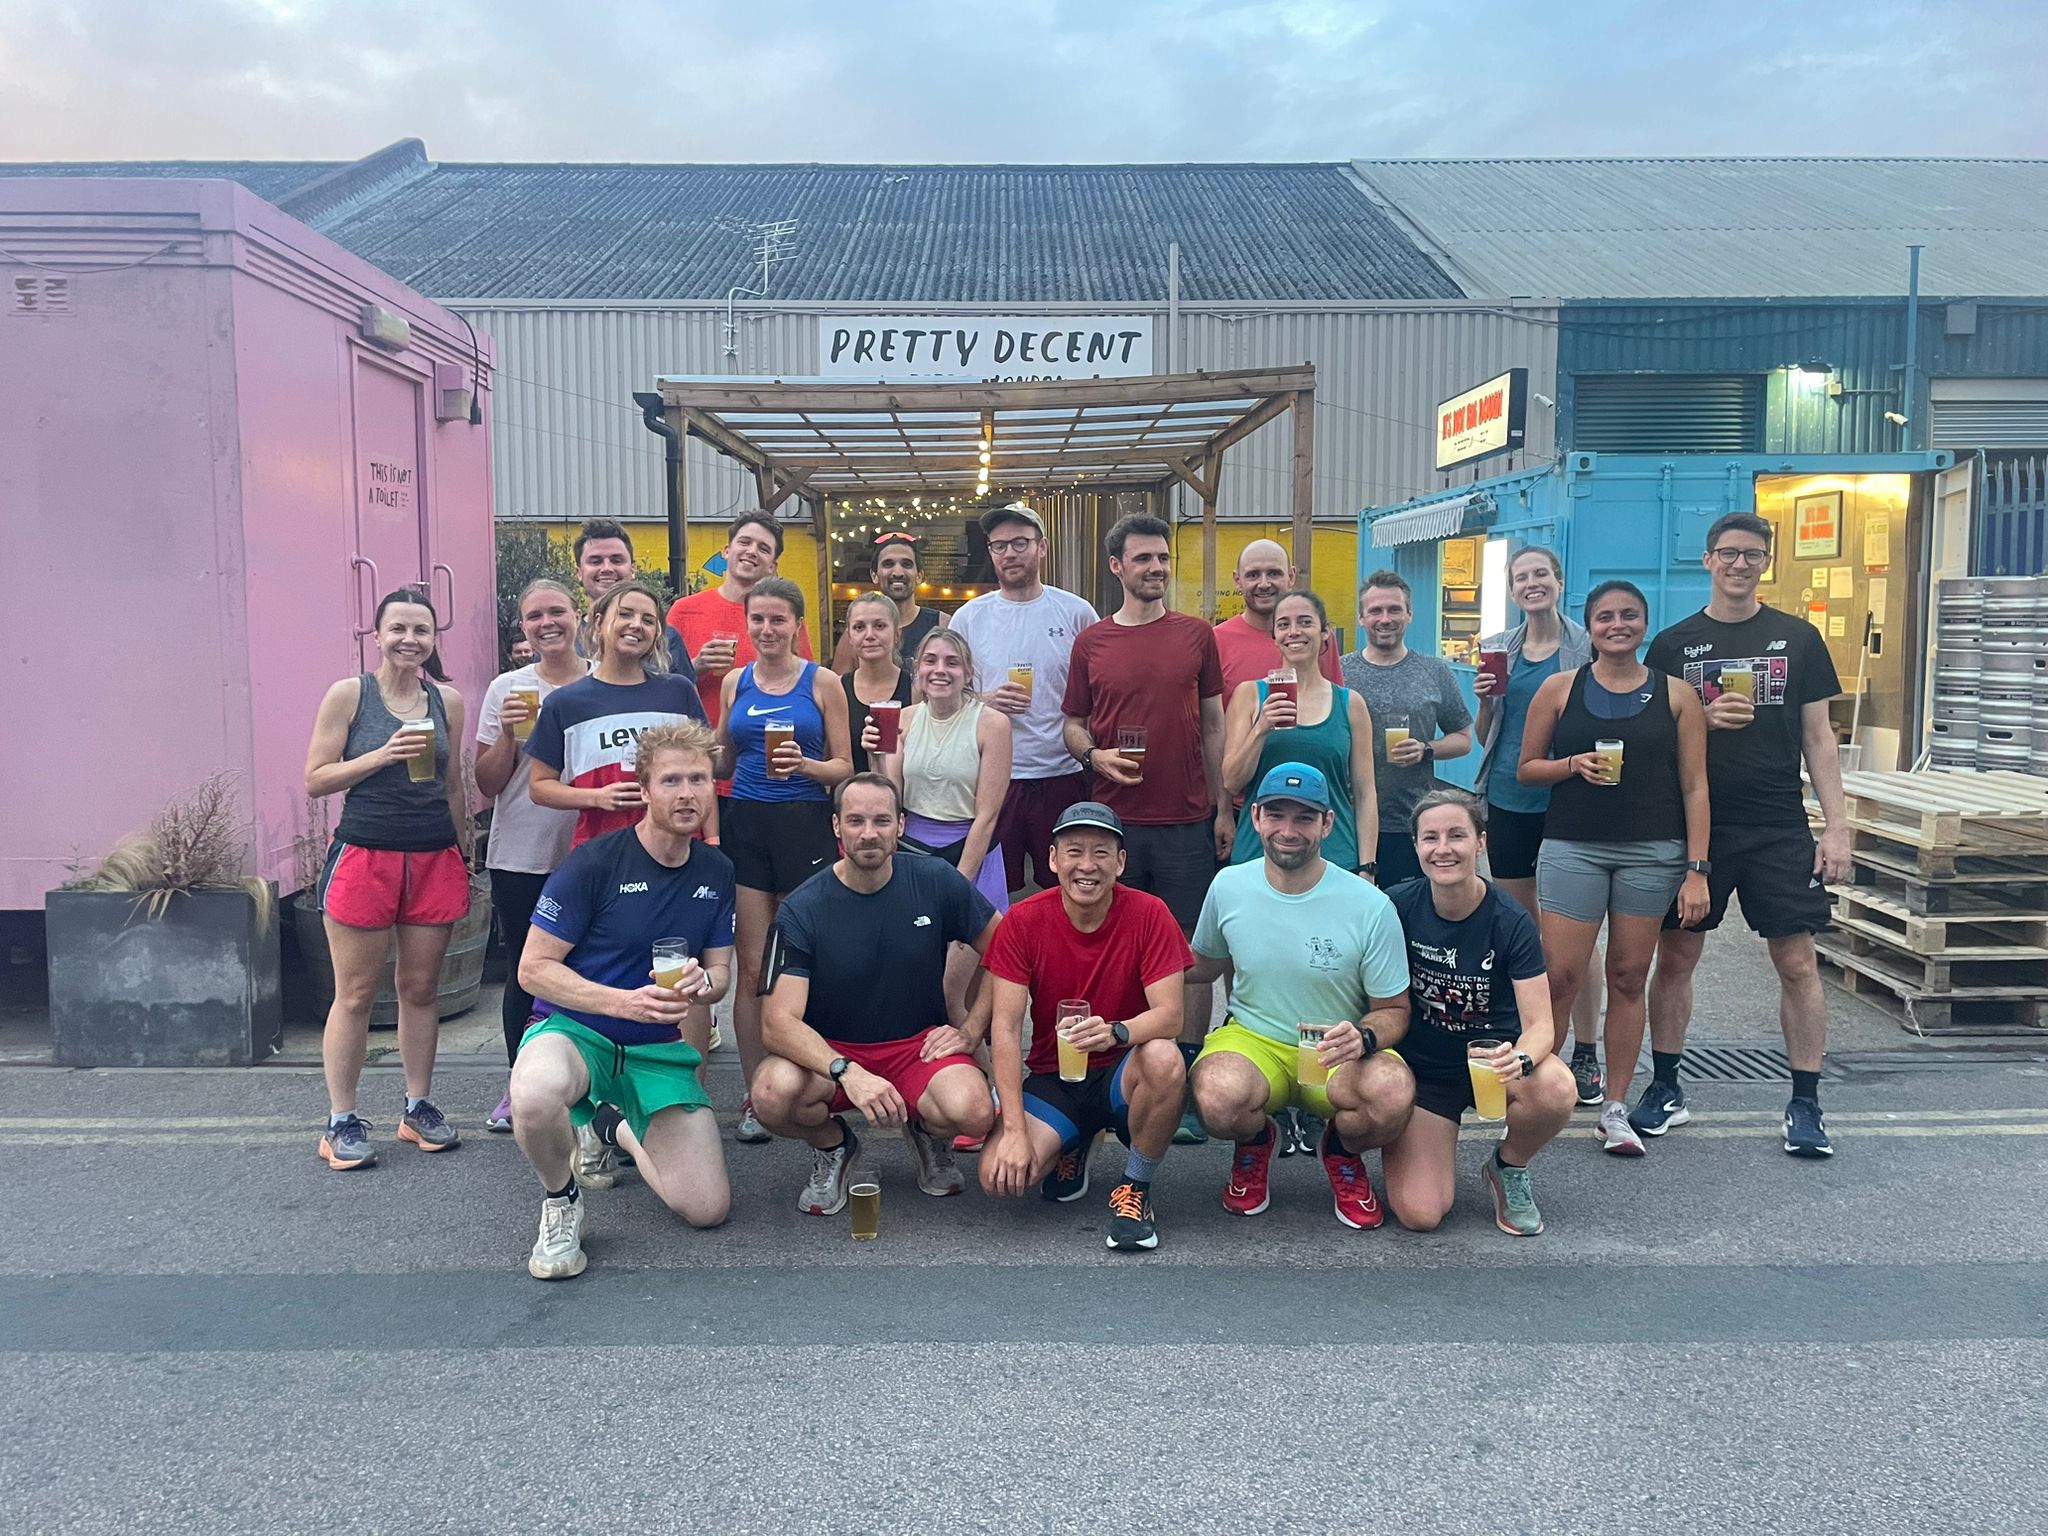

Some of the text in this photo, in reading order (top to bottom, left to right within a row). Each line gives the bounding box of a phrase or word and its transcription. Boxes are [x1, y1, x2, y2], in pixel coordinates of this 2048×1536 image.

[830, 328, 1143, 367] PRETTY DECENT
[370, 462, 412, 484] THIS IS NOT
[368, 487, 374, 504] A
[376, 487, 399, 508] TOILET
[619, 881, 649, 894] HOKA
[1421, 952, 1443, 963] PARIS
[1414, 961, 1491, 983] SCHNEIDER ELECTRIC
[1476, 983, 1491, 991] DE
